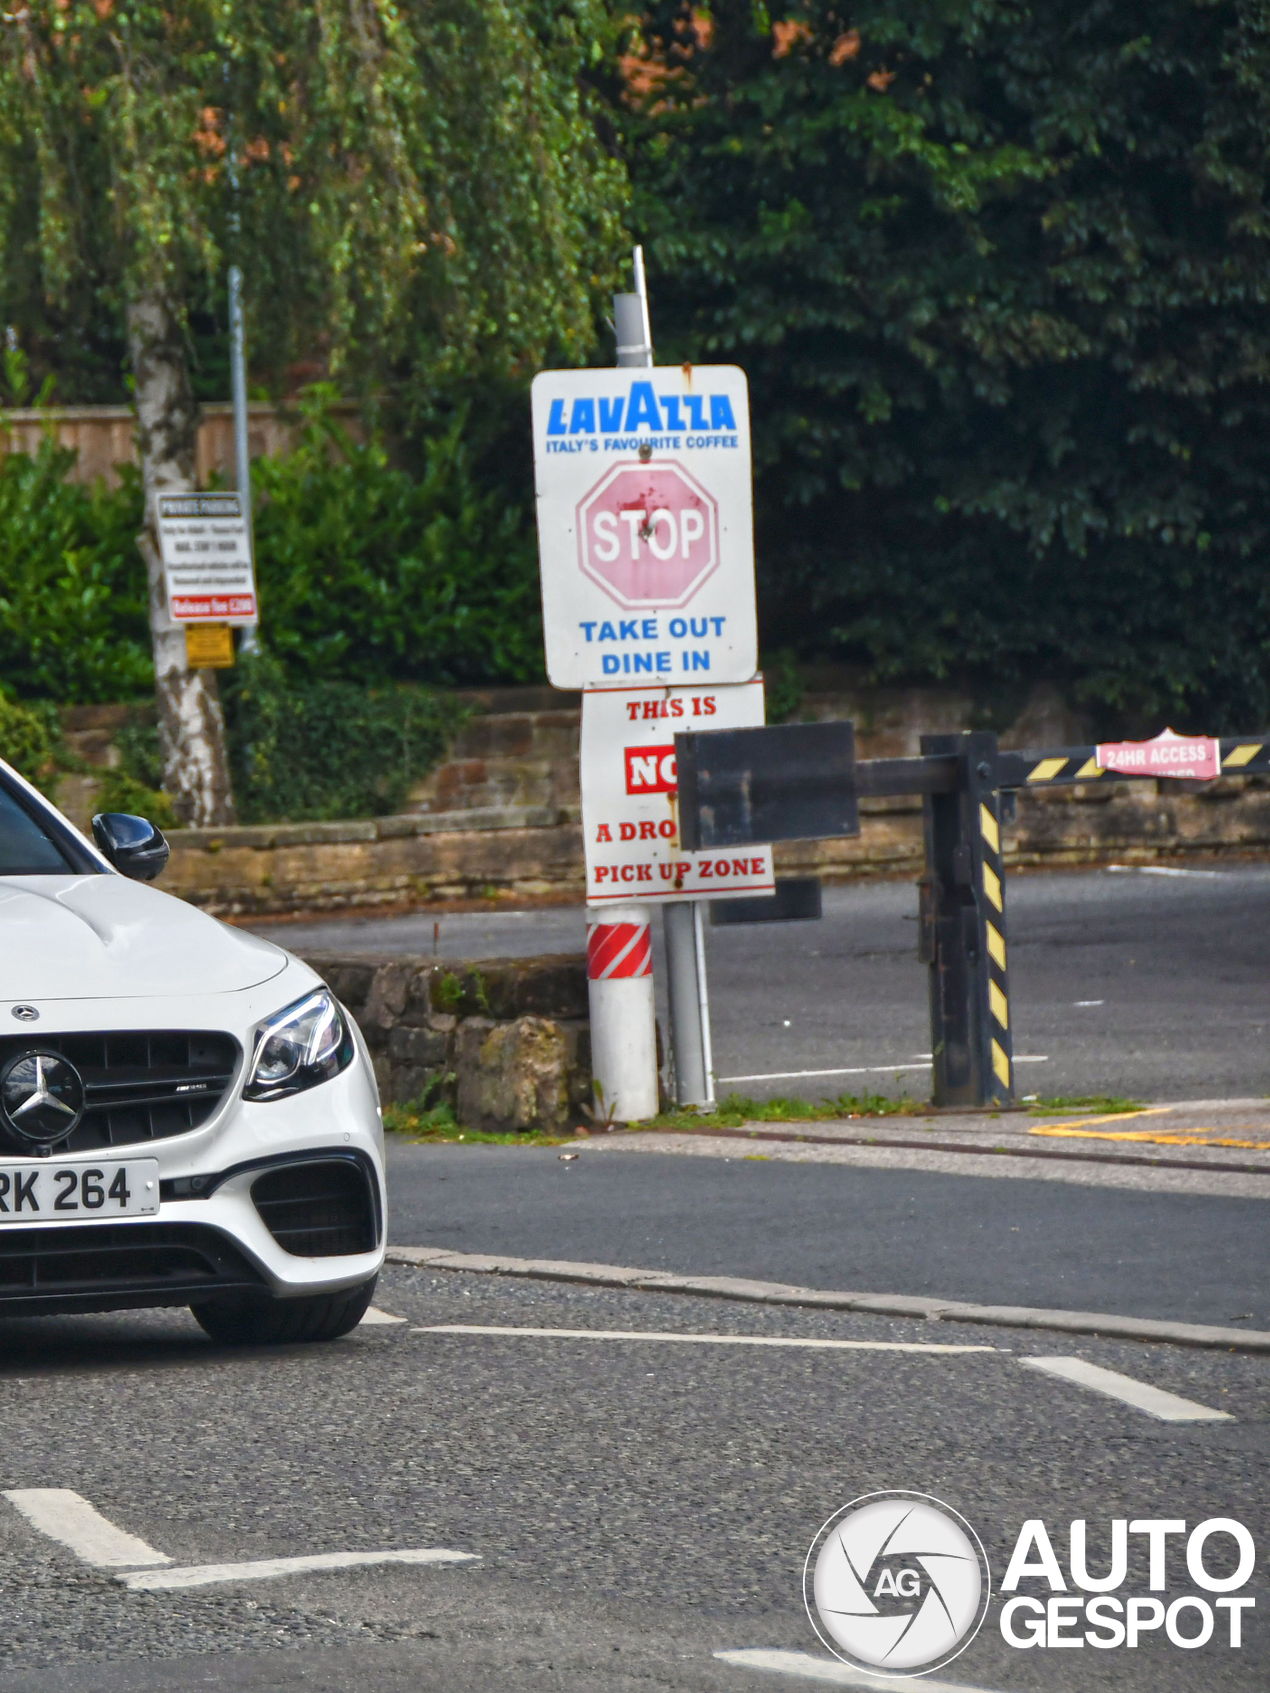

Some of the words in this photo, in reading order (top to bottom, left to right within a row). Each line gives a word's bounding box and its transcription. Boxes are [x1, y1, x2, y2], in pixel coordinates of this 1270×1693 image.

[546, 438, 598, 453] ITALY'S
[604, 435, 680, 450] FAVOURITE
[686, 434, 738, 448] COFFEE
[593, 508, 704, 562] STOP
[579, 619, 659, 642] TAKE
[669, 617, 726, 638] OUT
[602, 652, 672, 674] DINE
[682, 651, 710, 671] IN
[627, 699, 684, 720] THIS
[691, 696, 717, 716] IS
[1106, 749, 1146, 768] 24HR
[1151, 744, 1206, 764] ACCESS
[596, 824, 612, 842] A
[594, 864, 653, 883] PICK
[659, 862, 692, 880] UP
[698, 857, 765, 878] ZONE
[53, 1167, 130, 1210] 264
